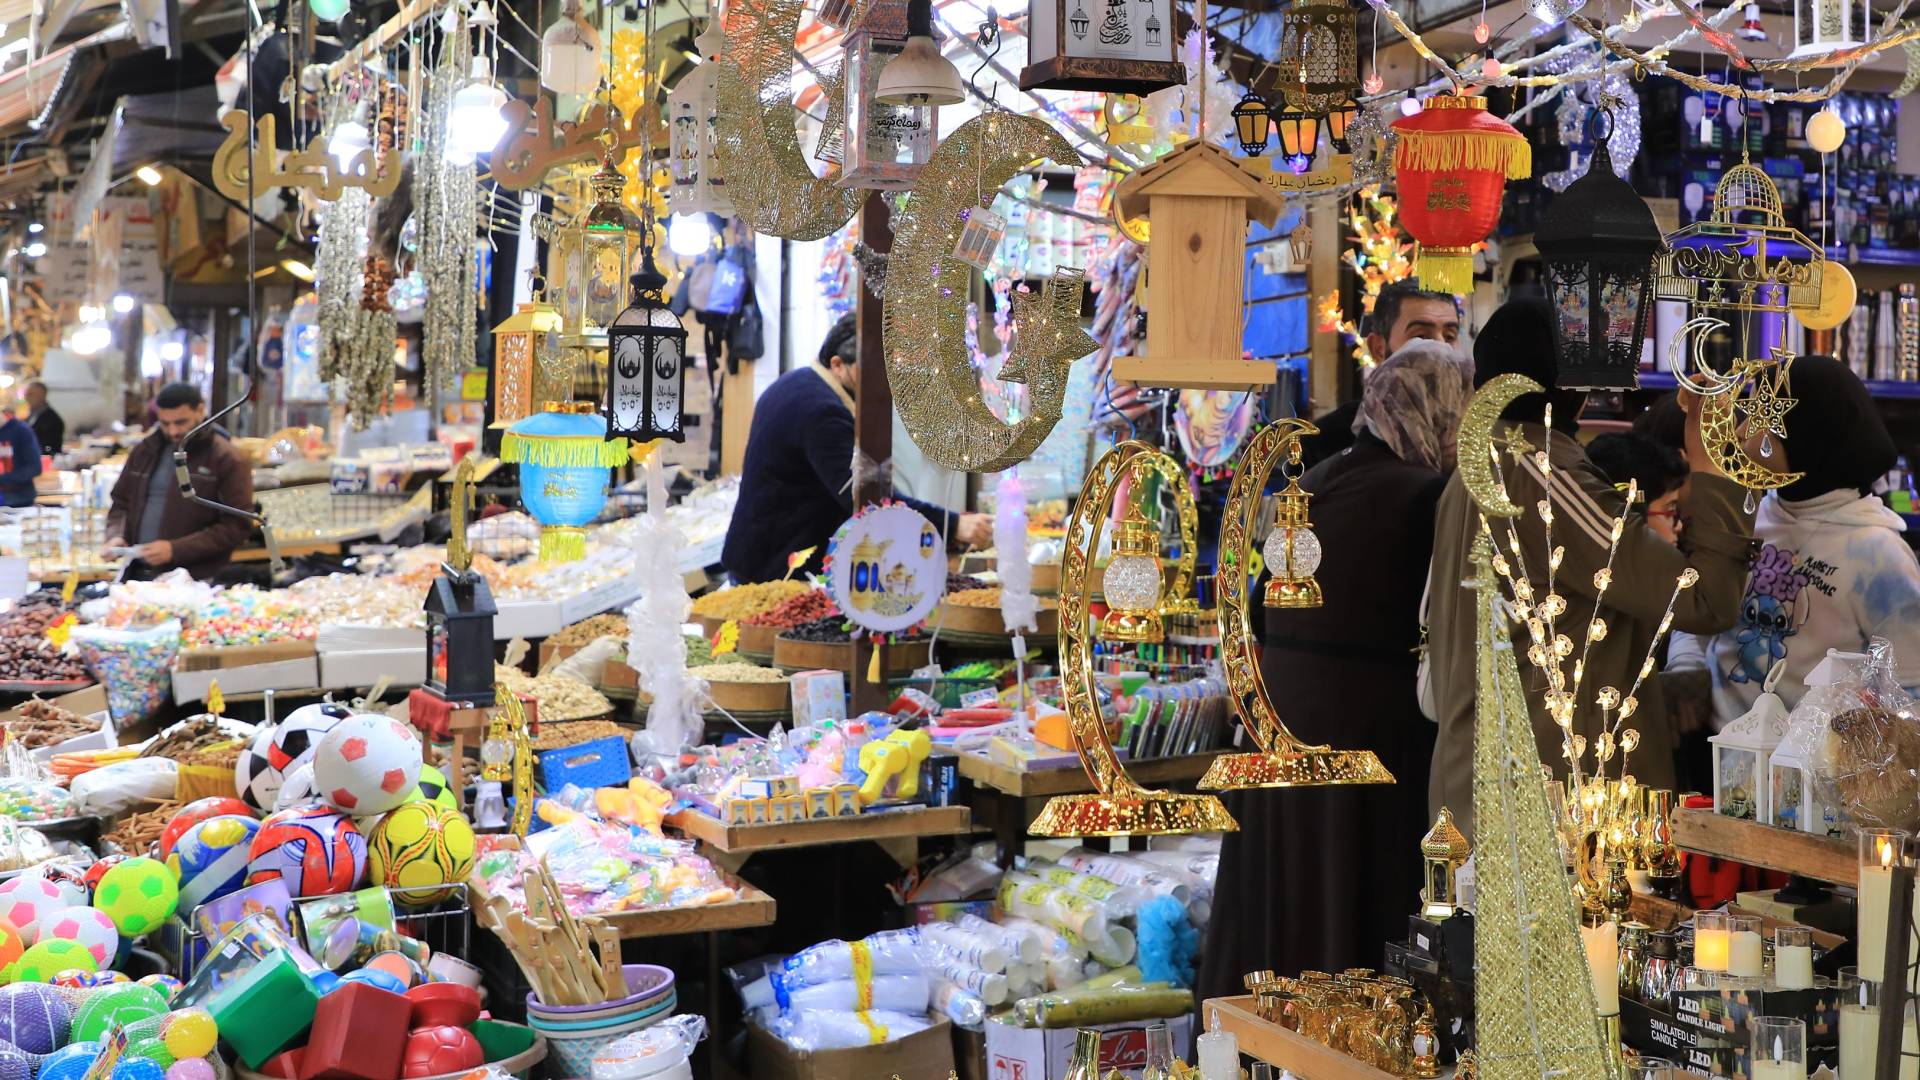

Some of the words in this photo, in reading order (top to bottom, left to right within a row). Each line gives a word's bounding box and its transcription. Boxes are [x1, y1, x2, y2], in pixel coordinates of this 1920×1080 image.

[1267, 175, 1294, 190] مبارك
[1297, 175, 1338, 189] رمضان
[1738, 236, 1813, 285] رمضان
[1825, 566, 1839, 577] IT
[1678, 996, 1700, 1013] LED
[1650, 1018, 1686, 1041] SIMULATED
[1676, 1012, 1703, 1027] CANDLE
[1704, 1019, 1726, 1034] LIGHT
[1651, 1030, 1678, 1048] CANDLE
[1689, 1049, 1712, 1068] LED
